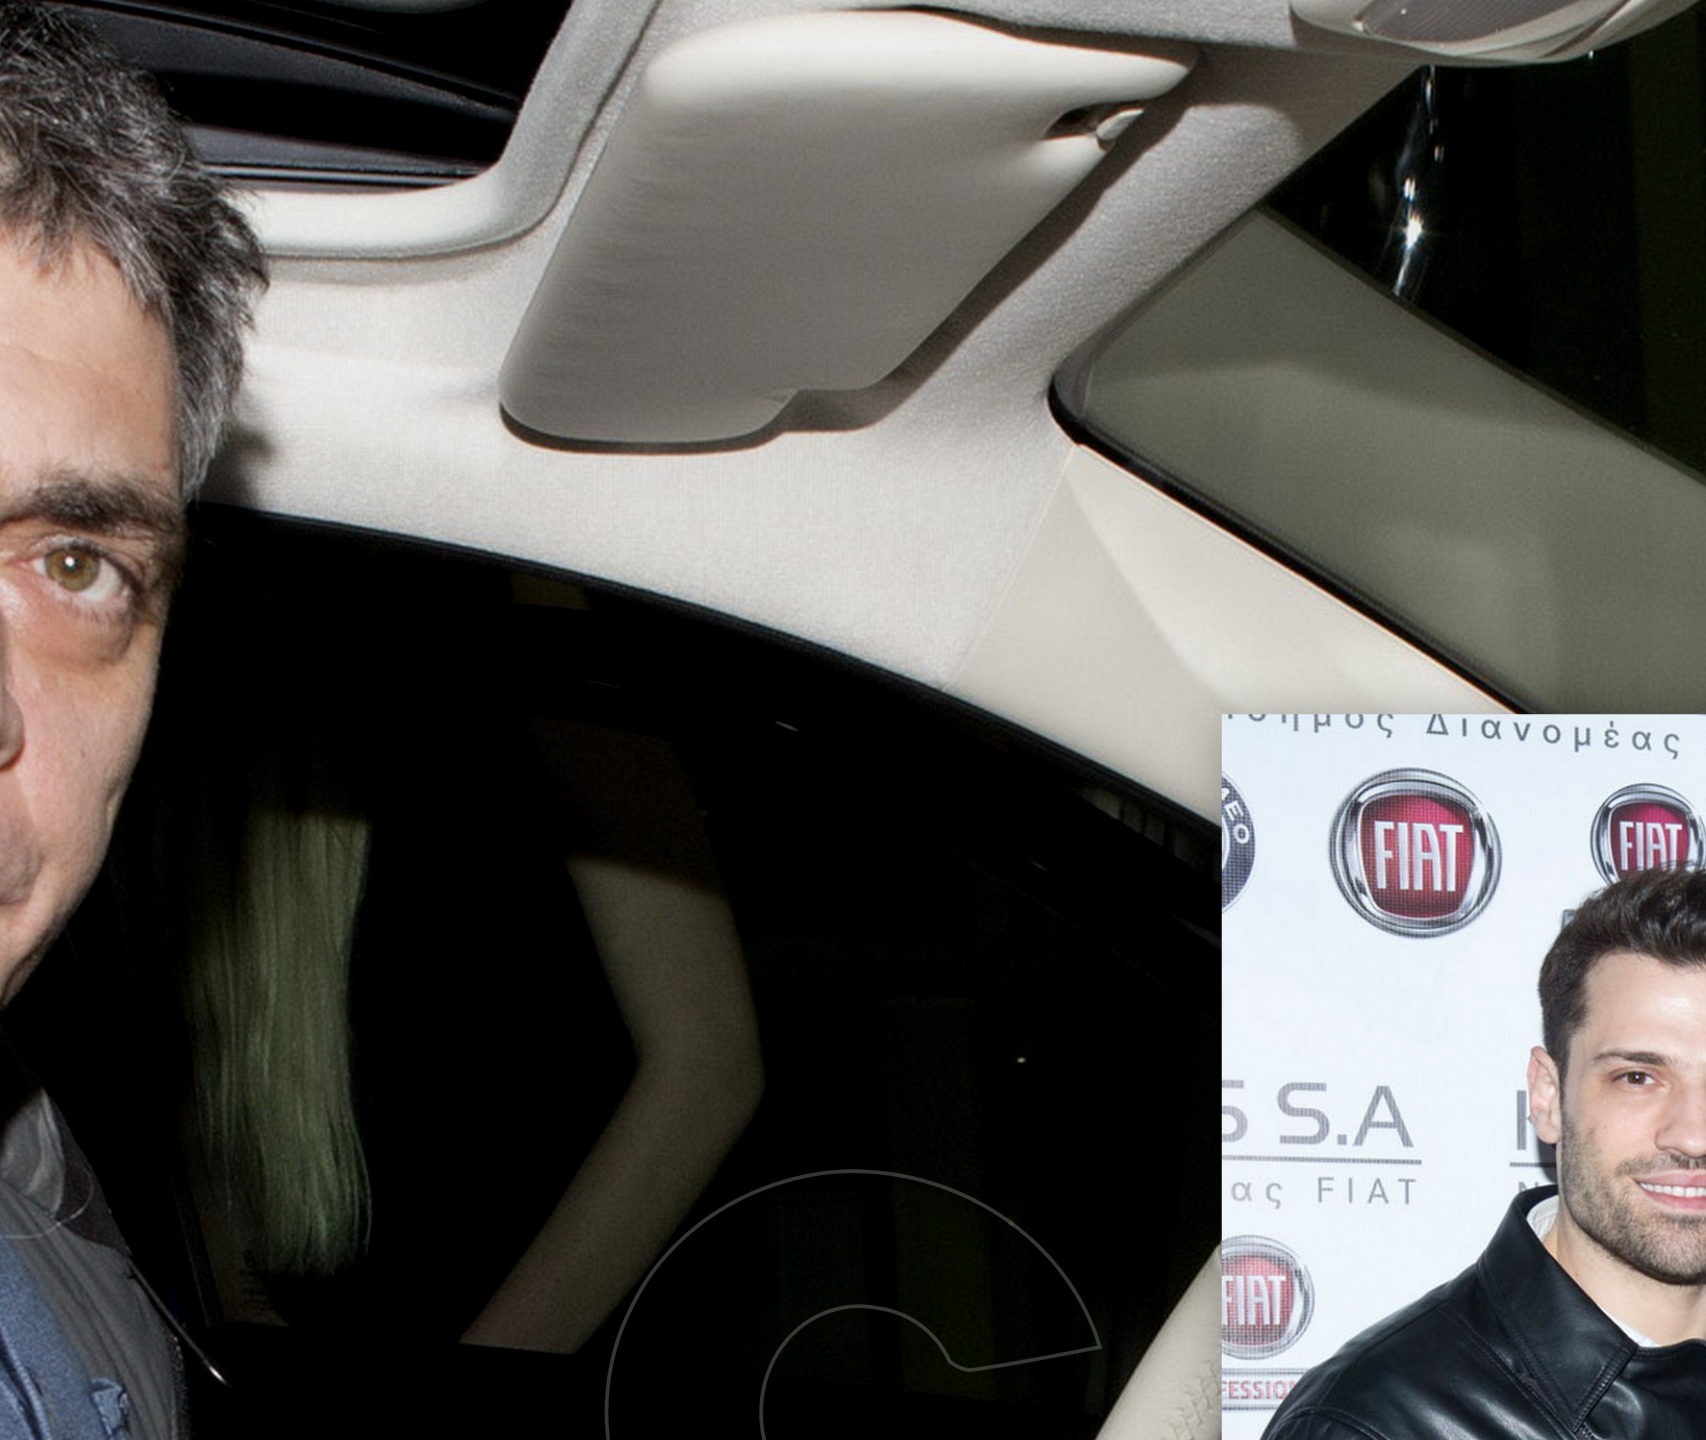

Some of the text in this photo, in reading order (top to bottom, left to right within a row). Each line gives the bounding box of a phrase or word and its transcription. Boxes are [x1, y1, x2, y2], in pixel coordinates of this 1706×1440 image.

[1425, 714, 1681, 760] Διανομέας
[1373, 819, 1464, 892] FIAT
[1619, 820, 1683, 872] FIAT
[1276, 1081, 1414, 1148] S.A
[1316, 1176, 1417, 1205] FIAT
[1222, 1274, 1287, 1326] FIAT
